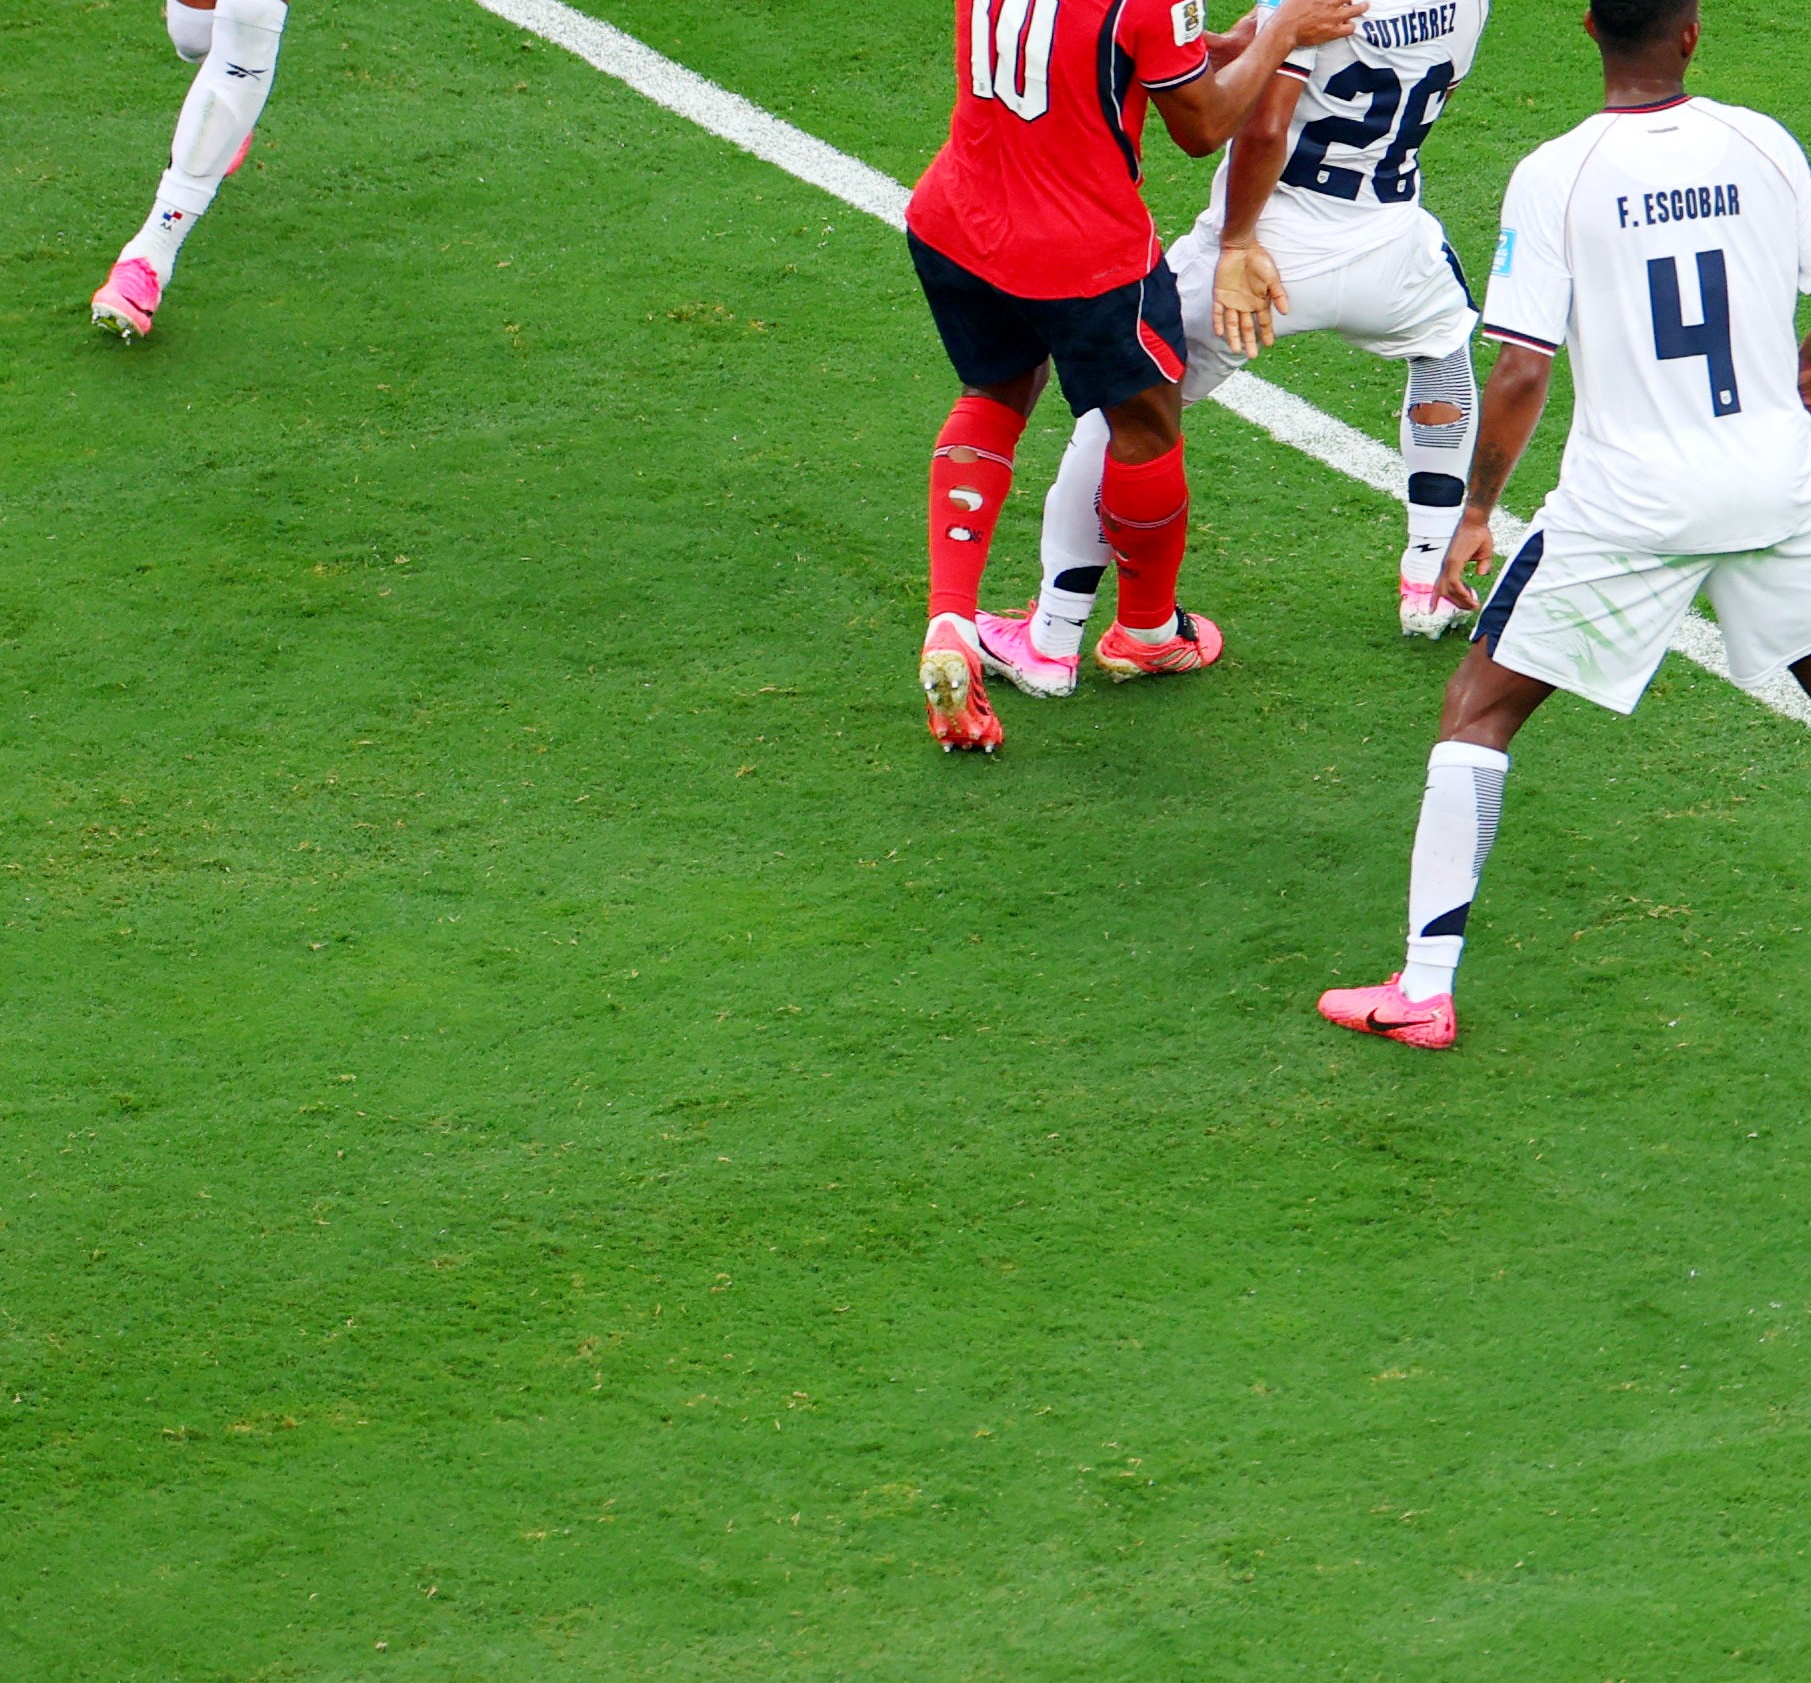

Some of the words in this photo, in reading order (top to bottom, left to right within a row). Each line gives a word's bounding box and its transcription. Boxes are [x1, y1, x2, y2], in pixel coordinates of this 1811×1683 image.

[1362, 1, 1457, 49] GUTIÉRREZ
[1279, 60, 1455, 204] 26
[1616, 195, 1640, 229] F.
[1643, 183, 1741, 227] ESCOBAR
[1646, 248, 1743, 418] 4
